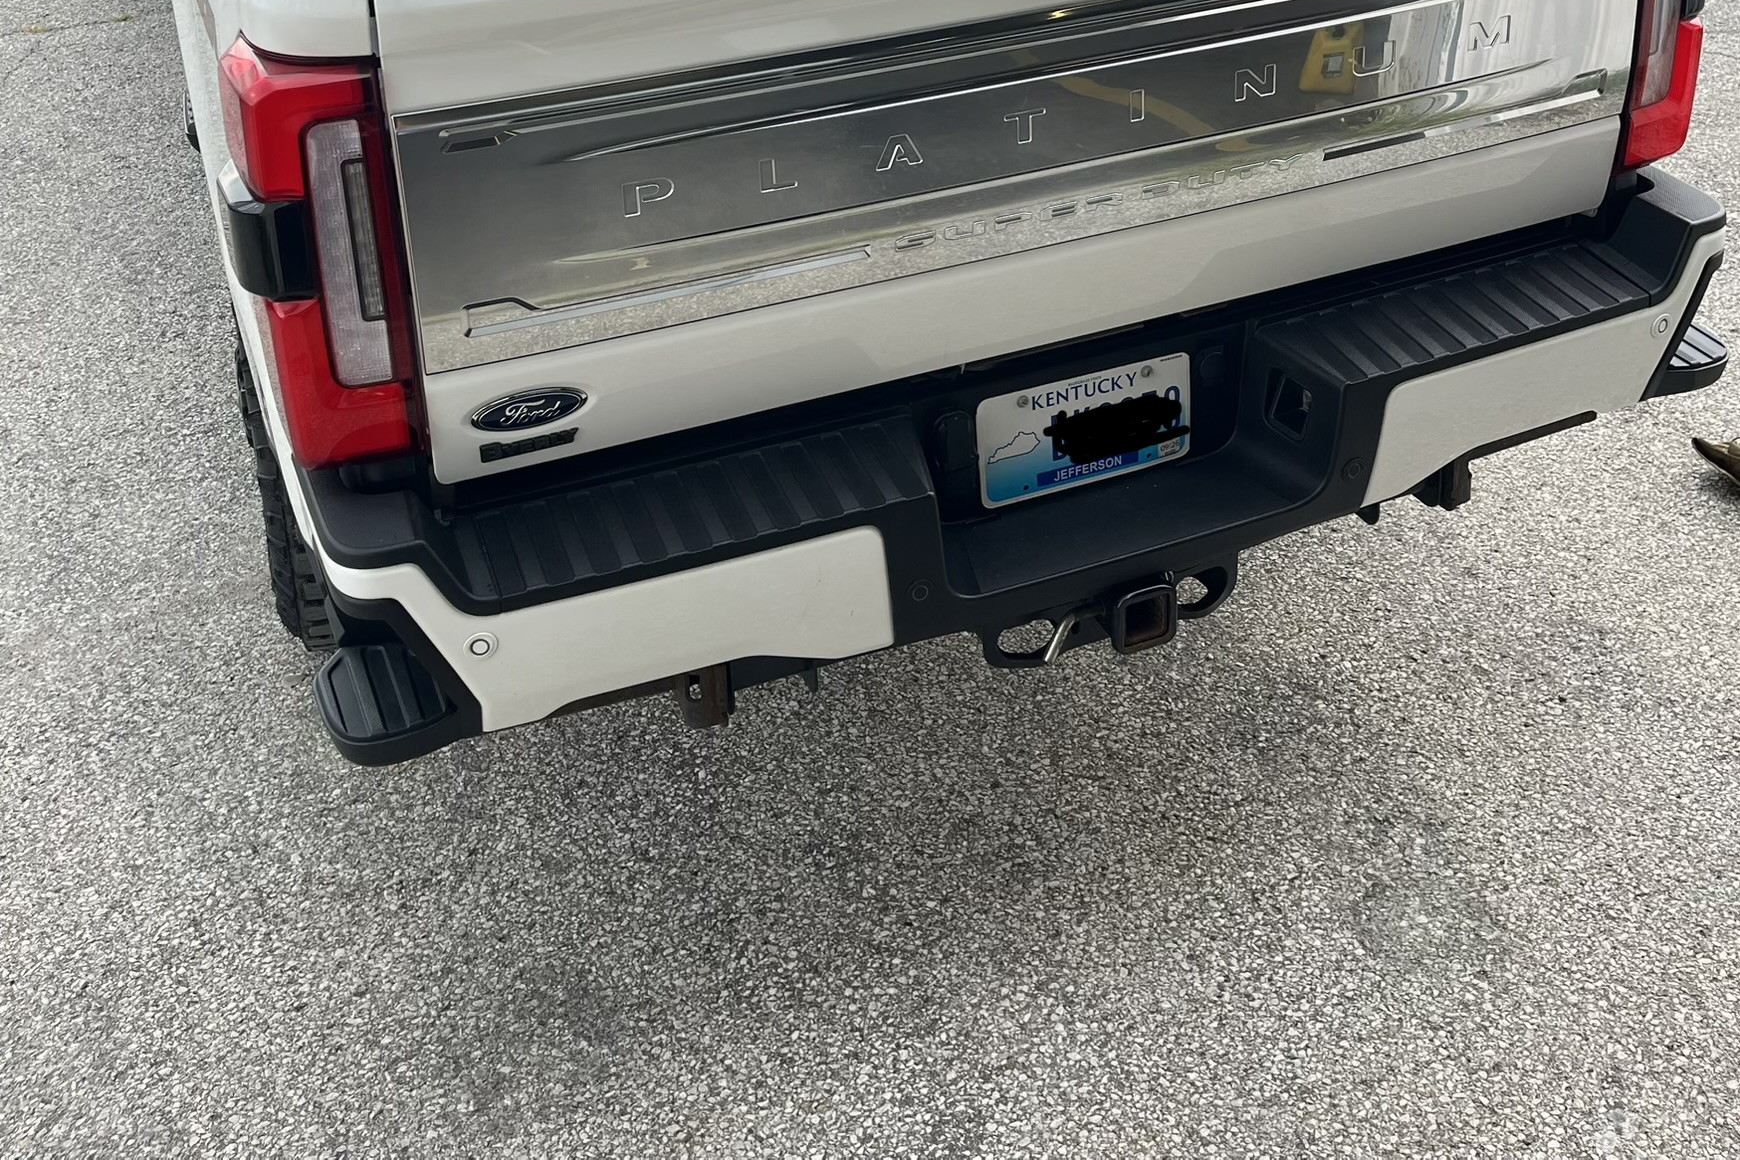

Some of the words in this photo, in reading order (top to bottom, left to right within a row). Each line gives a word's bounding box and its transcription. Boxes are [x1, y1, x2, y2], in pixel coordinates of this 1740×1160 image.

[623, 14, 1512, 218] PLATINUM
[895, 192, 1124, 252] SUPER
[1142, 153, 1303, 200] DUTY
[1031, 371, 1138, 411] KENTUCKY
[500, 398, 562, 425] Ford
[1054, 455, 1122, 482] JEFFERSON
